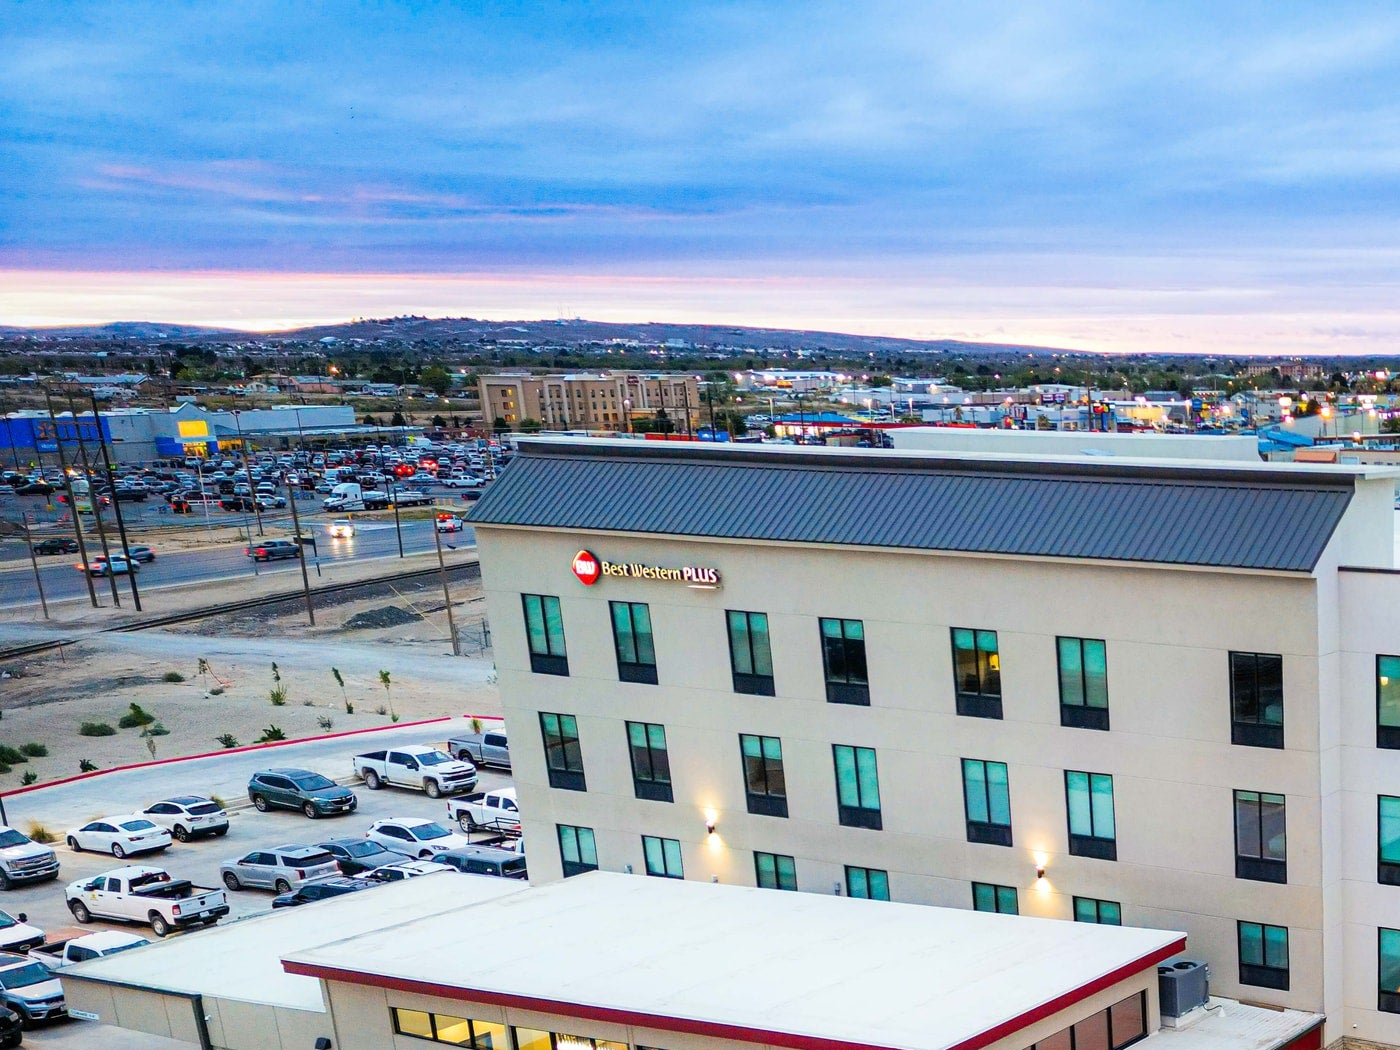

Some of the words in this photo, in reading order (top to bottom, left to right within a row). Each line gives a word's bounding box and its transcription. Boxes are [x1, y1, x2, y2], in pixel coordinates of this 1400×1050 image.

[601, 561, 629, 576] Best
[630, 563, 681, 580] Western
[682, 566, 717, 583] PLUS
